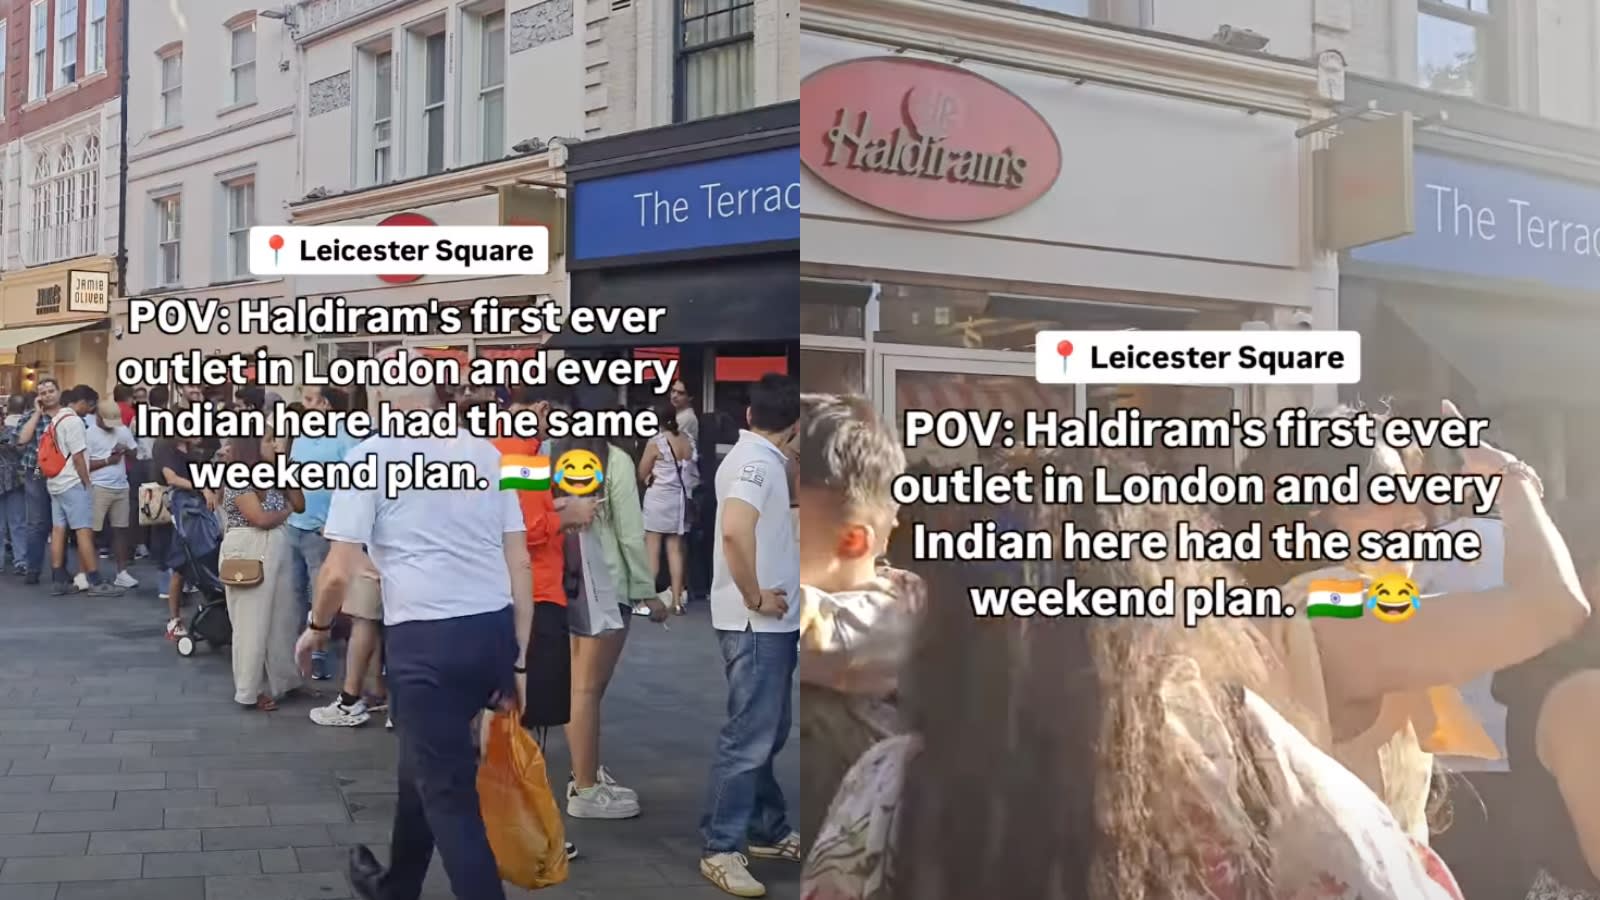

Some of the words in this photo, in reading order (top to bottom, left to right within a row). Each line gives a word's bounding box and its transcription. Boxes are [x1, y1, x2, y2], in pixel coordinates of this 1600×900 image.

[633, 190, 689, 227] The
[699, 182, 800, 219] Terrac
[1425, 183, 1496, 241] The
